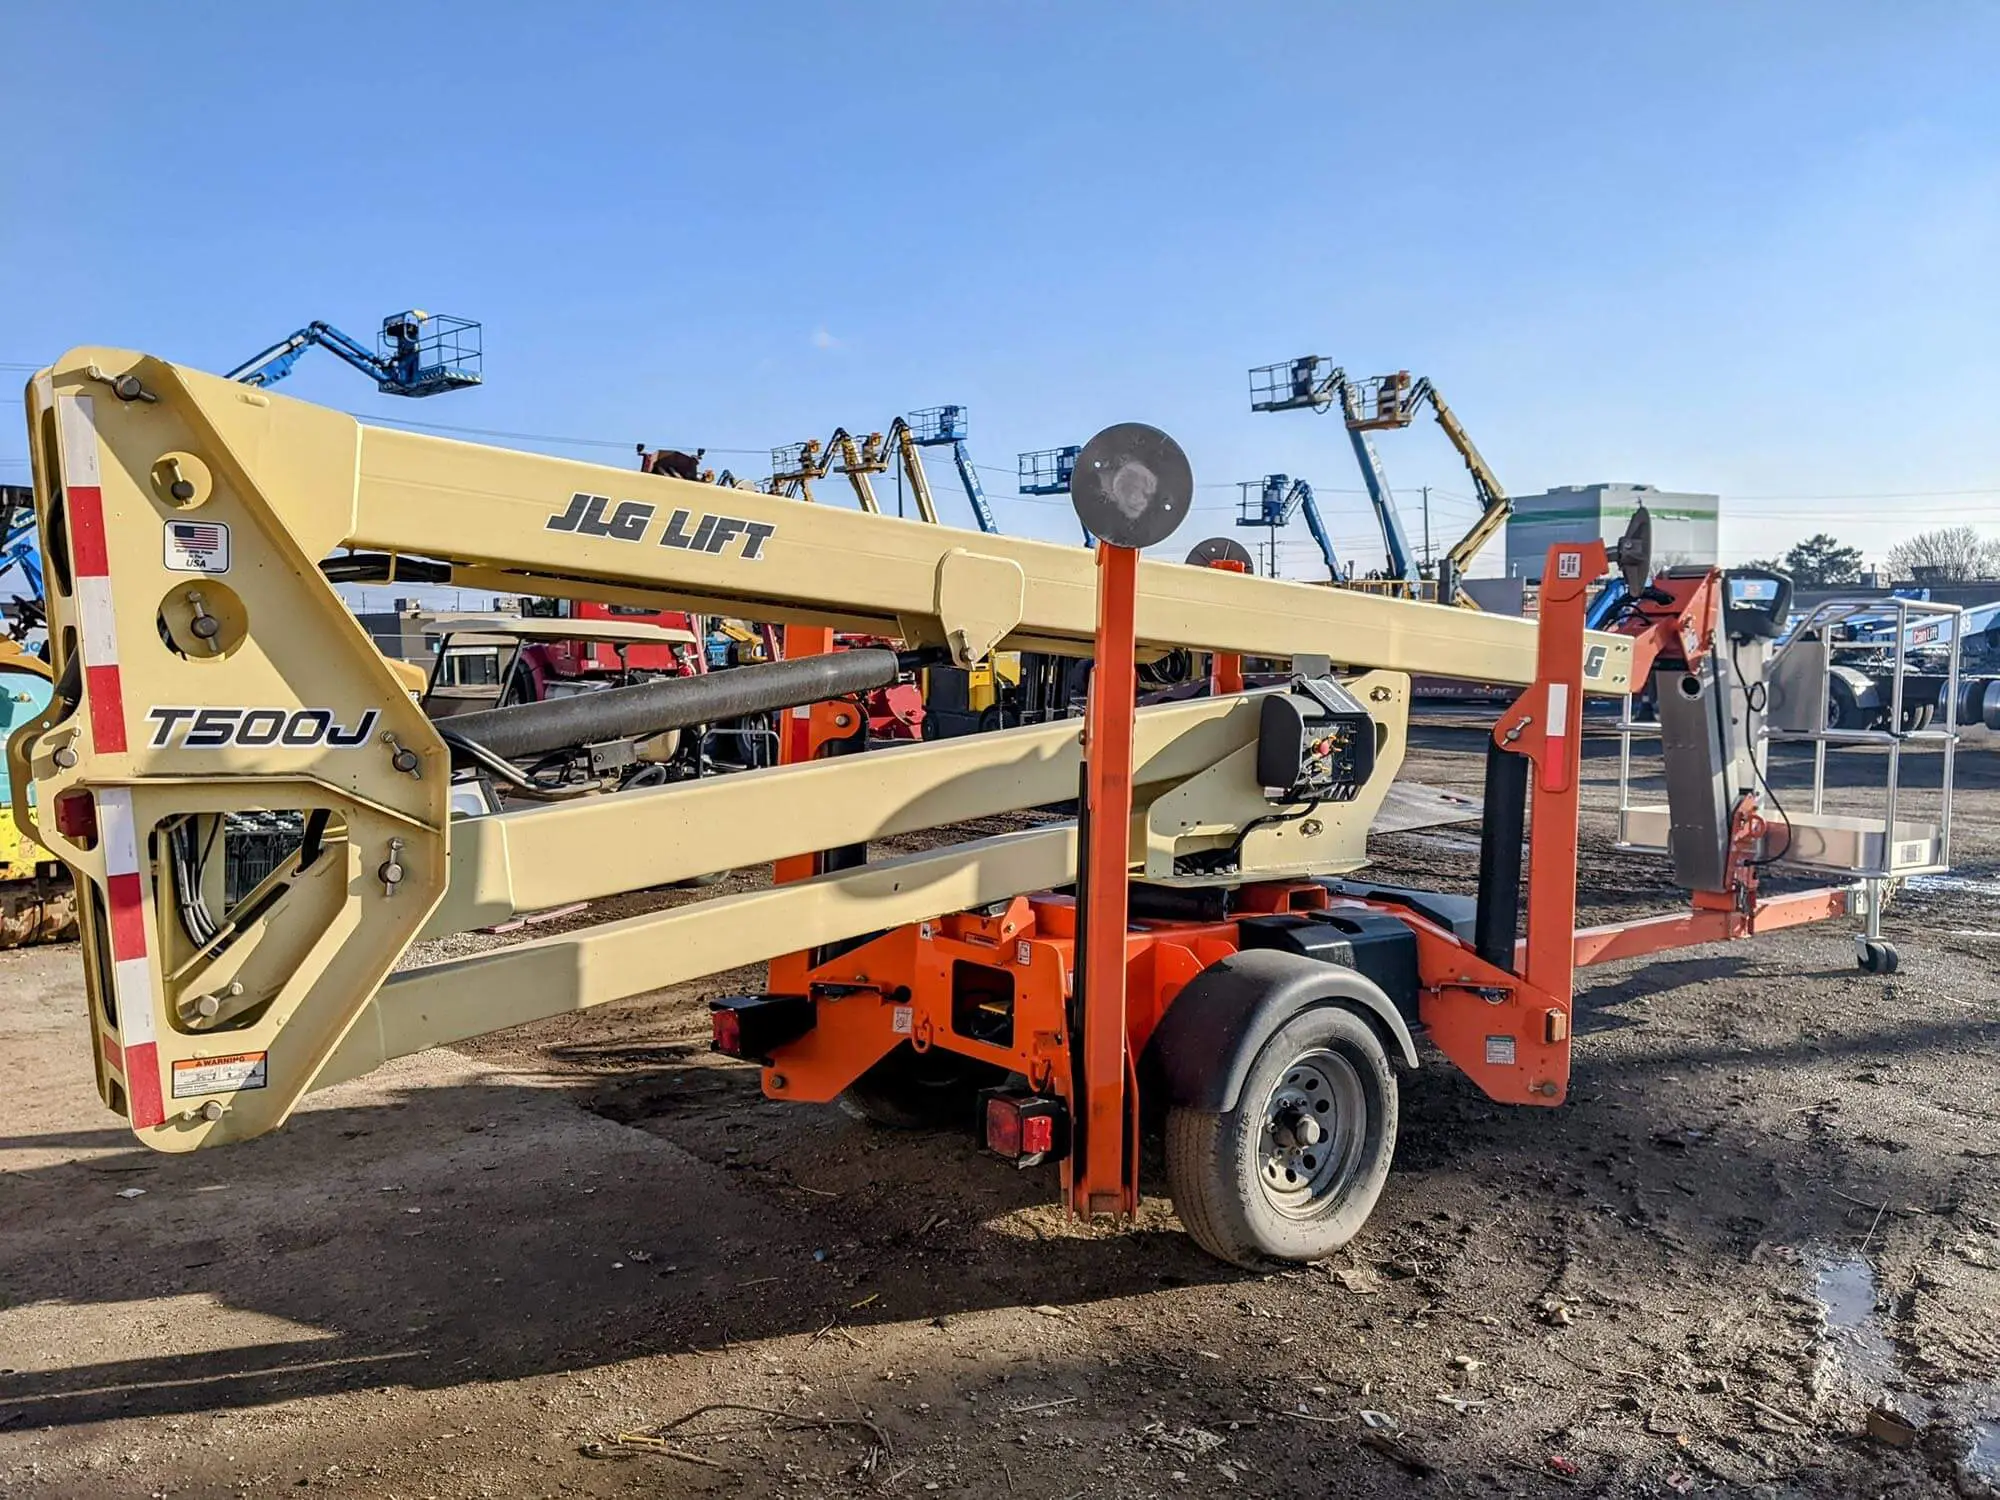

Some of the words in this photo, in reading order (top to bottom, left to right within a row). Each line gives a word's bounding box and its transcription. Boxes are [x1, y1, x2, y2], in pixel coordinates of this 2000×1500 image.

[545, 492, 656, 543] JLG
[657, 508, 777, 560] LIFT
[186, 559, 206, 568] USA
[144, 705, 382, 750] T500J
[203, 1056, 246, 1067] WARNING
